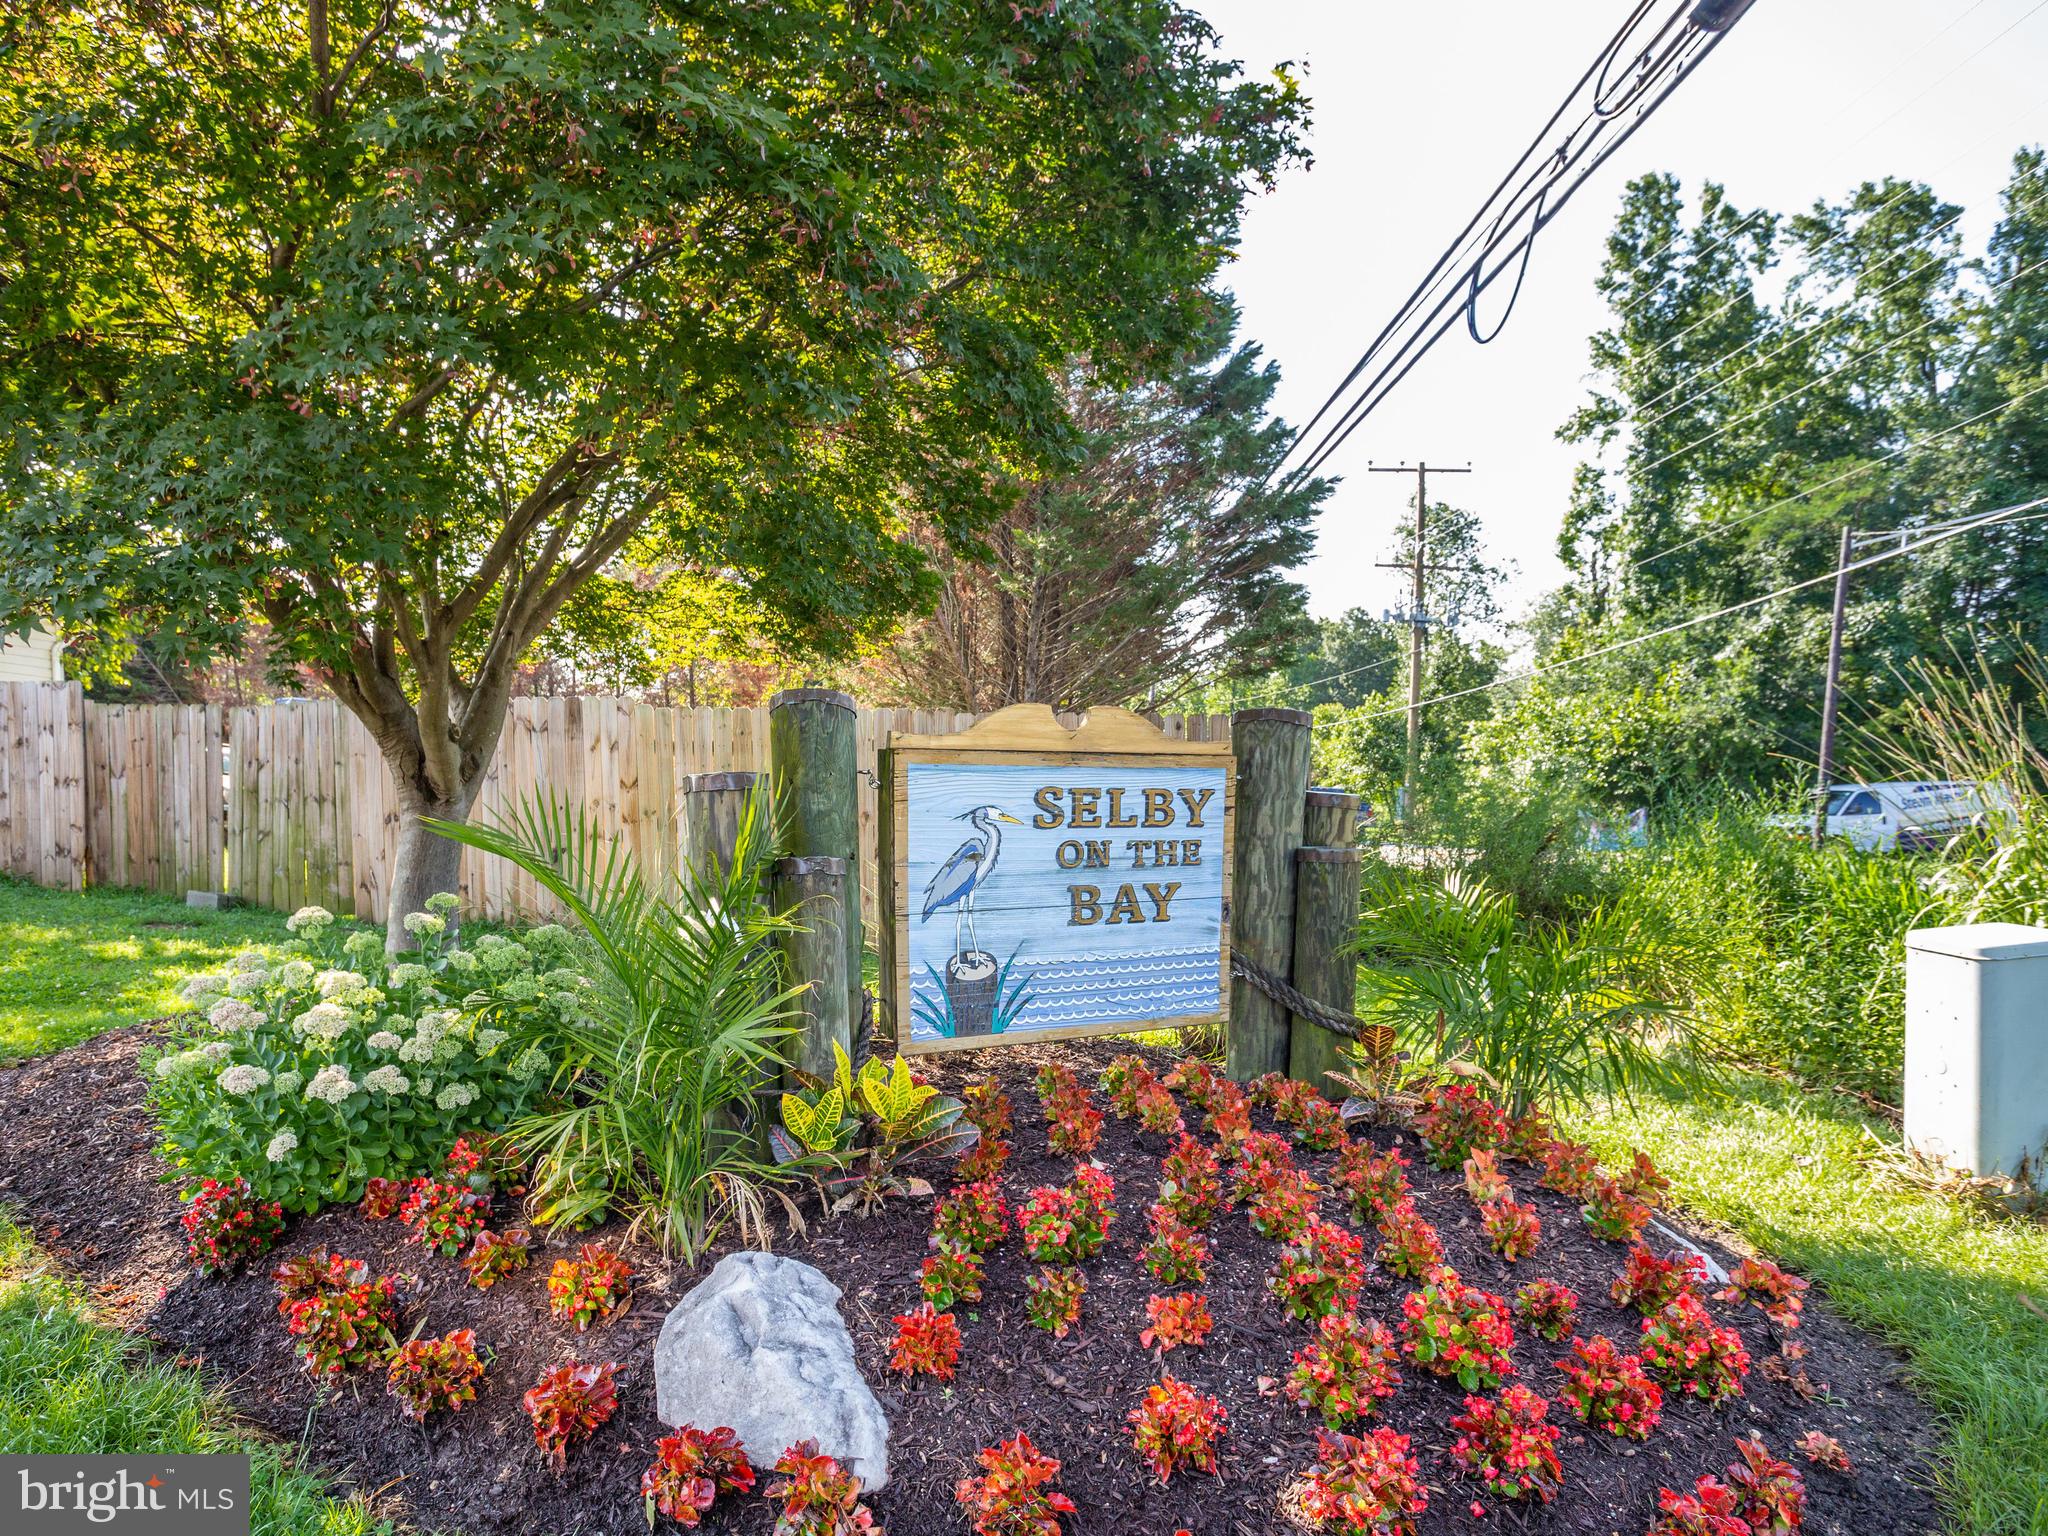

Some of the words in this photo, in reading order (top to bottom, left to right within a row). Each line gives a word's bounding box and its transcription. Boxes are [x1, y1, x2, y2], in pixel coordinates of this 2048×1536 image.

[1033, 786, 1215, 829] SELBY
[1055, 839, 1112, 869] ON
[1126, 839, 1202, 868] THE
[1067, 882, 1181, 926] BAY
